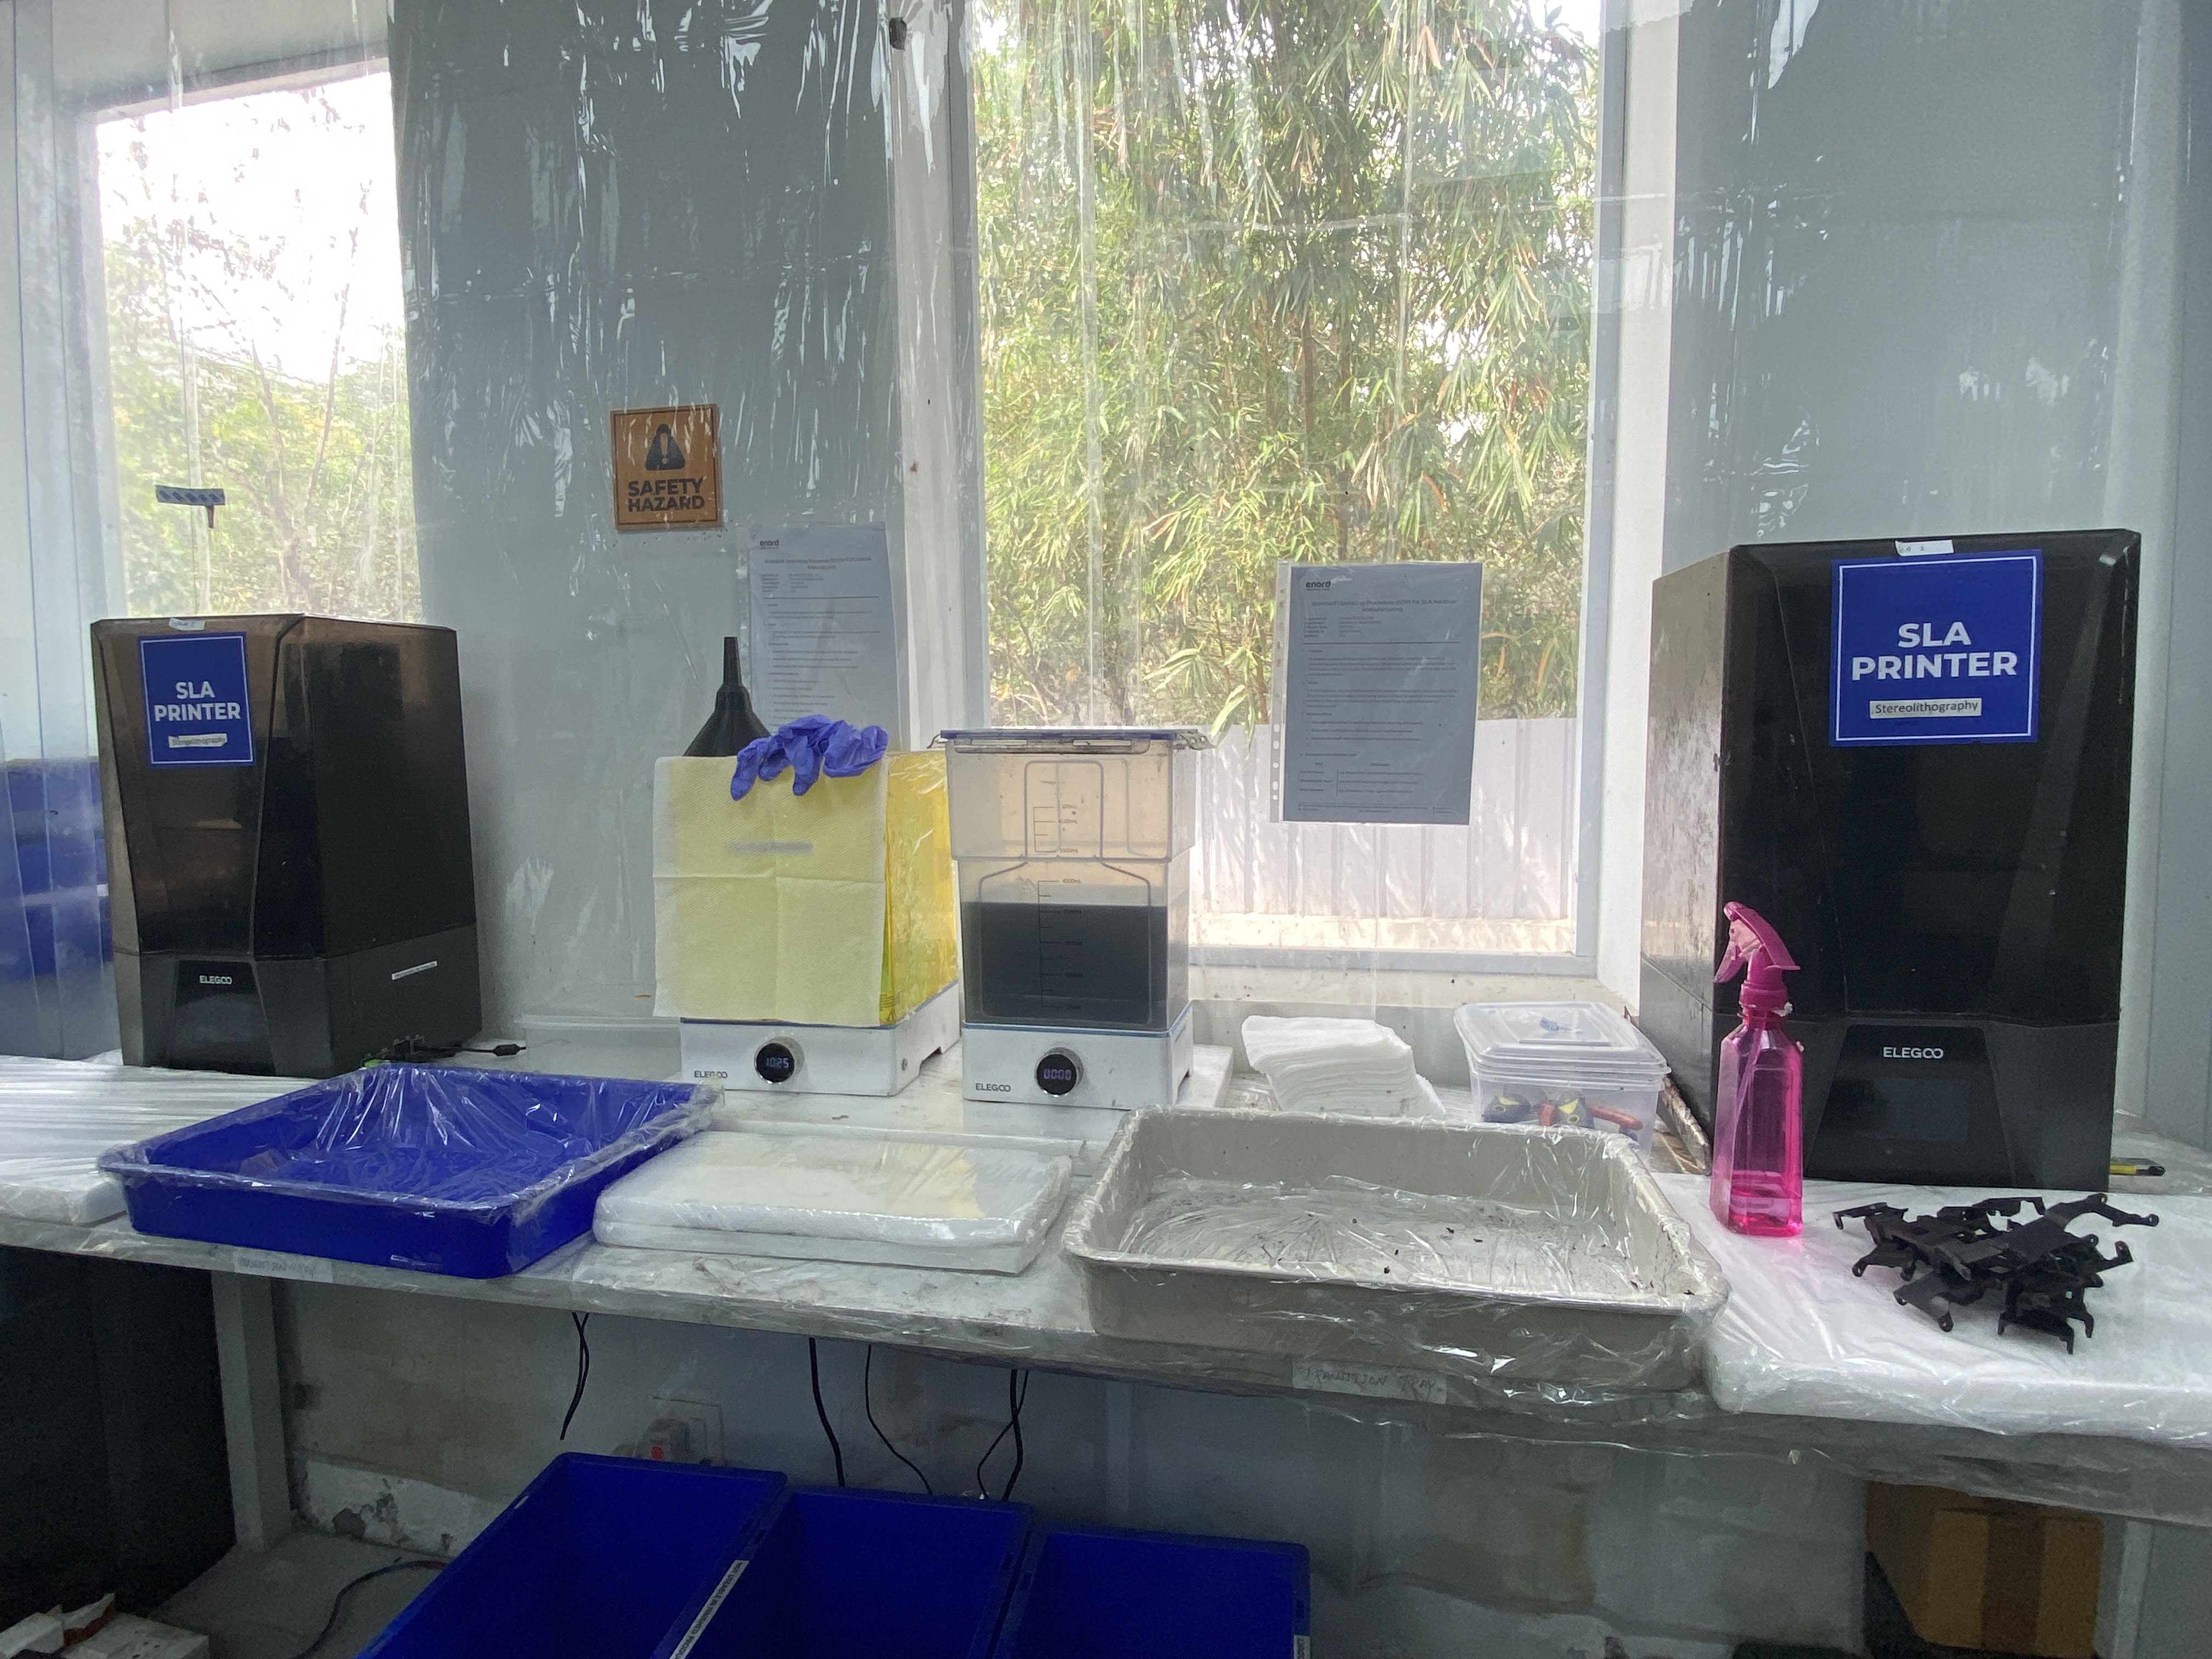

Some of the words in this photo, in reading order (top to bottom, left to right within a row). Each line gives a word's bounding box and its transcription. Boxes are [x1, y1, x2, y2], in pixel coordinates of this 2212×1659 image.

[628, 476, 704, 496] SAFETY
[628, 495, 705, 512] HAZARD
[1898, 622, 1972, 648] SLA
[1852, 651, 2018, 681] PRINTER
[175, 681, 215, 699] SLA
[154, 702, 241, 722] PRINTER
[1875, 700, 1979, 714] Stereolithography
[199, 975, 232, 985] ELEGOO
[1883, 1046, 1944, 1059] ELEGOO
[975, 1083, 1011, 1092] ELEGOO
